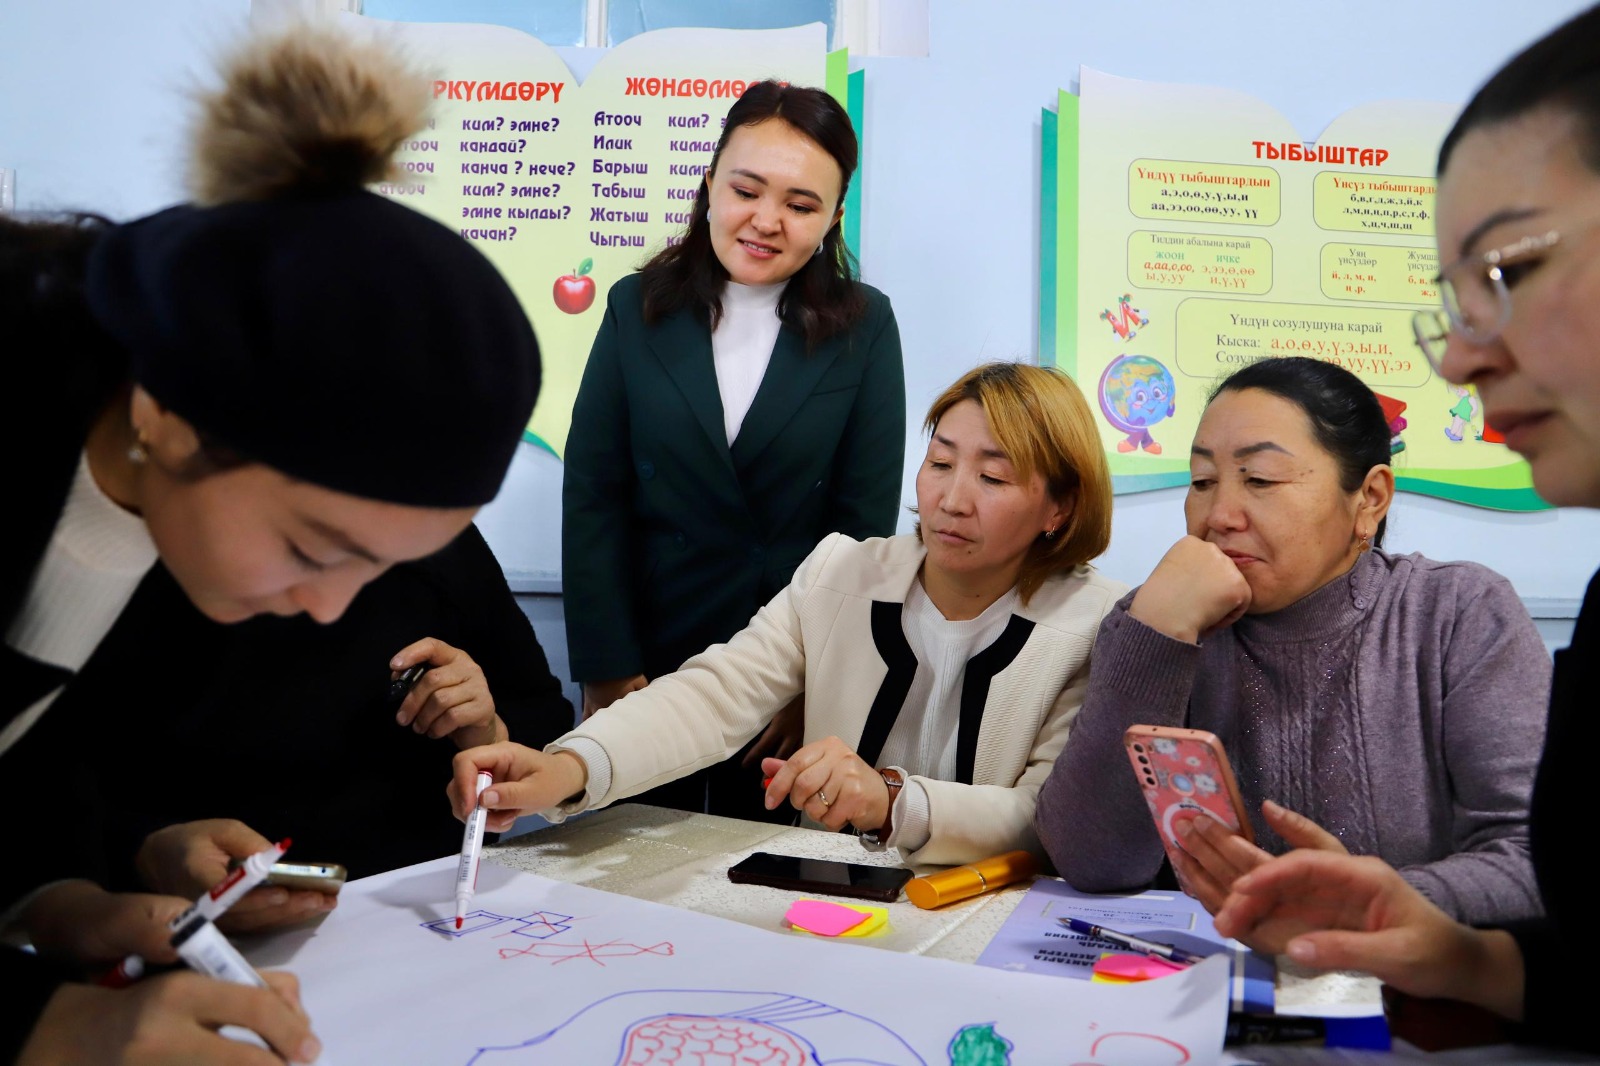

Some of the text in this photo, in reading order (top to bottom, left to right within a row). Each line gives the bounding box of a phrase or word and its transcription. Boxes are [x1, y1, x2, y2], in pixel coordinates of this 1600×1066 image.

[430, 80, 564, 103] РКҮМДӨРҮ
[625, 77, 790, 99] ЖӨНДӨМӨ
[462, 117, 560, 133] ким? эмне?
[594, 111, 642, 127] Атооч
[668, 113, 710, 128] ким?
[402, 140, 439, 152] тооч
[460, 139, 527, 153] кандай?
[593, 135, 632, 150] Илик
[1252, 141, 1389, 167] ТЫБЫШТАР
[461, 163, 508, 175] канча
[529, 162, 576, 176] нече?
[592, 159, 648, 177] Барыш
[1180, 172, 1271, 188] тыбыштардын
[463, 183, 561, 198] ким? эмне?
[591, 183, 646, 200] Табыш
[462, 206, 571, 221] эмне кылды?
[589, 207, 649, 223] Жатыш
[461, 226, 517, 241] качан?
[589, 231, 645, 248] Чыгыш
[1150, 234, 1251, 250] Тилдин абалына карай
[1156, 251, 1241, 264] жоон ичке
[1230, 313, 1383, 336] Үндүн созулушуна карай
[1216, 334, 1261, 348] Кыска:
